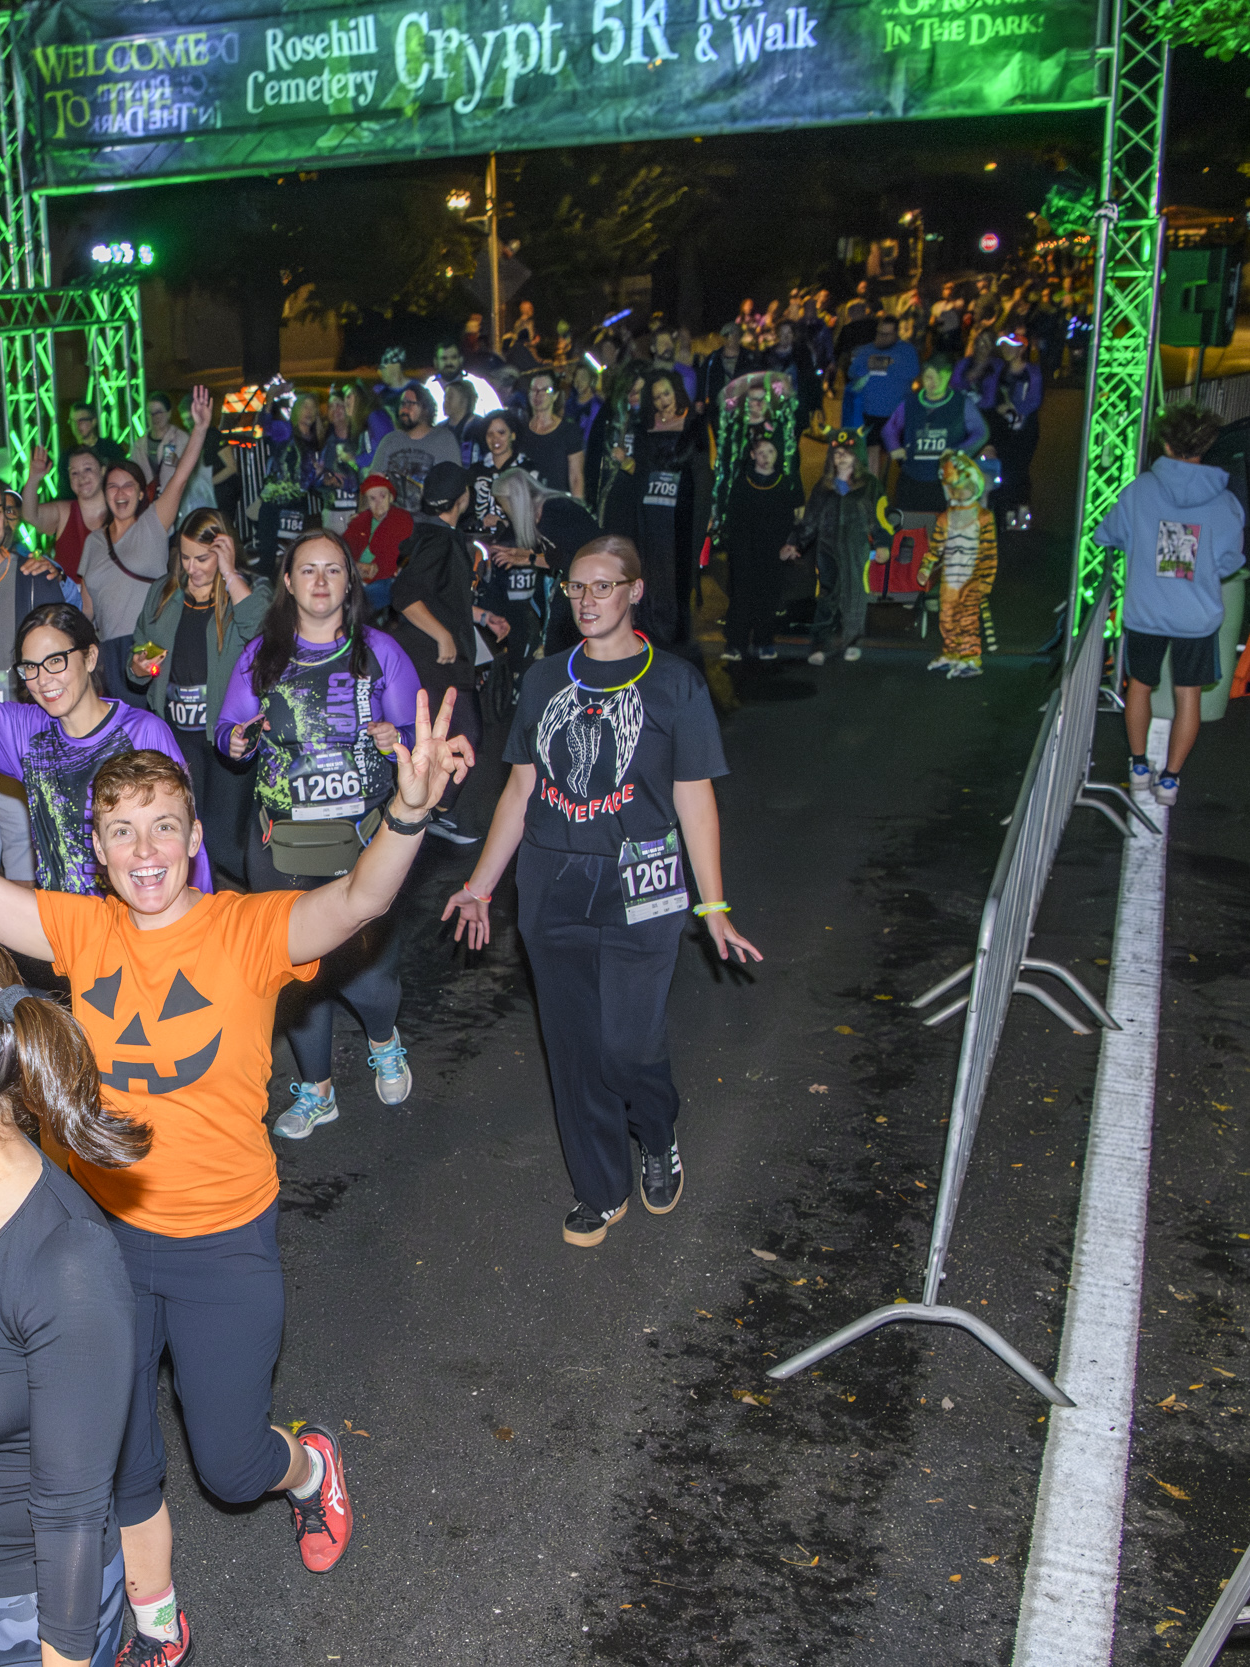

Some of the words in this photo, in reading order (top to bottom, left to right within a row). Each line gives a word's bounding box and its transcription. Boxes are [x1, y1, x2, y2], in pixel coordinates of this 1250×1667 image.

[265, 13, 378, 73] Rosehill
[694, 22, 719, 63] &
[729, 6, 818, 65] Walk
[32, 32, 210, 84] WELCOME
[395, 5, 567, 114] Crypt
[592, 0, 679, 66] 5K
[245, 66, 378, 114] Cemetery
[916, 438, 946, 451] 1710
[648, 481, 677, 496] 1709
[509, 573, 536, 589] 1311
[168, 701, 207, 725] 1072
[293, 771, 360, 802] 1266
[622, 856, 678, 897] 1267
